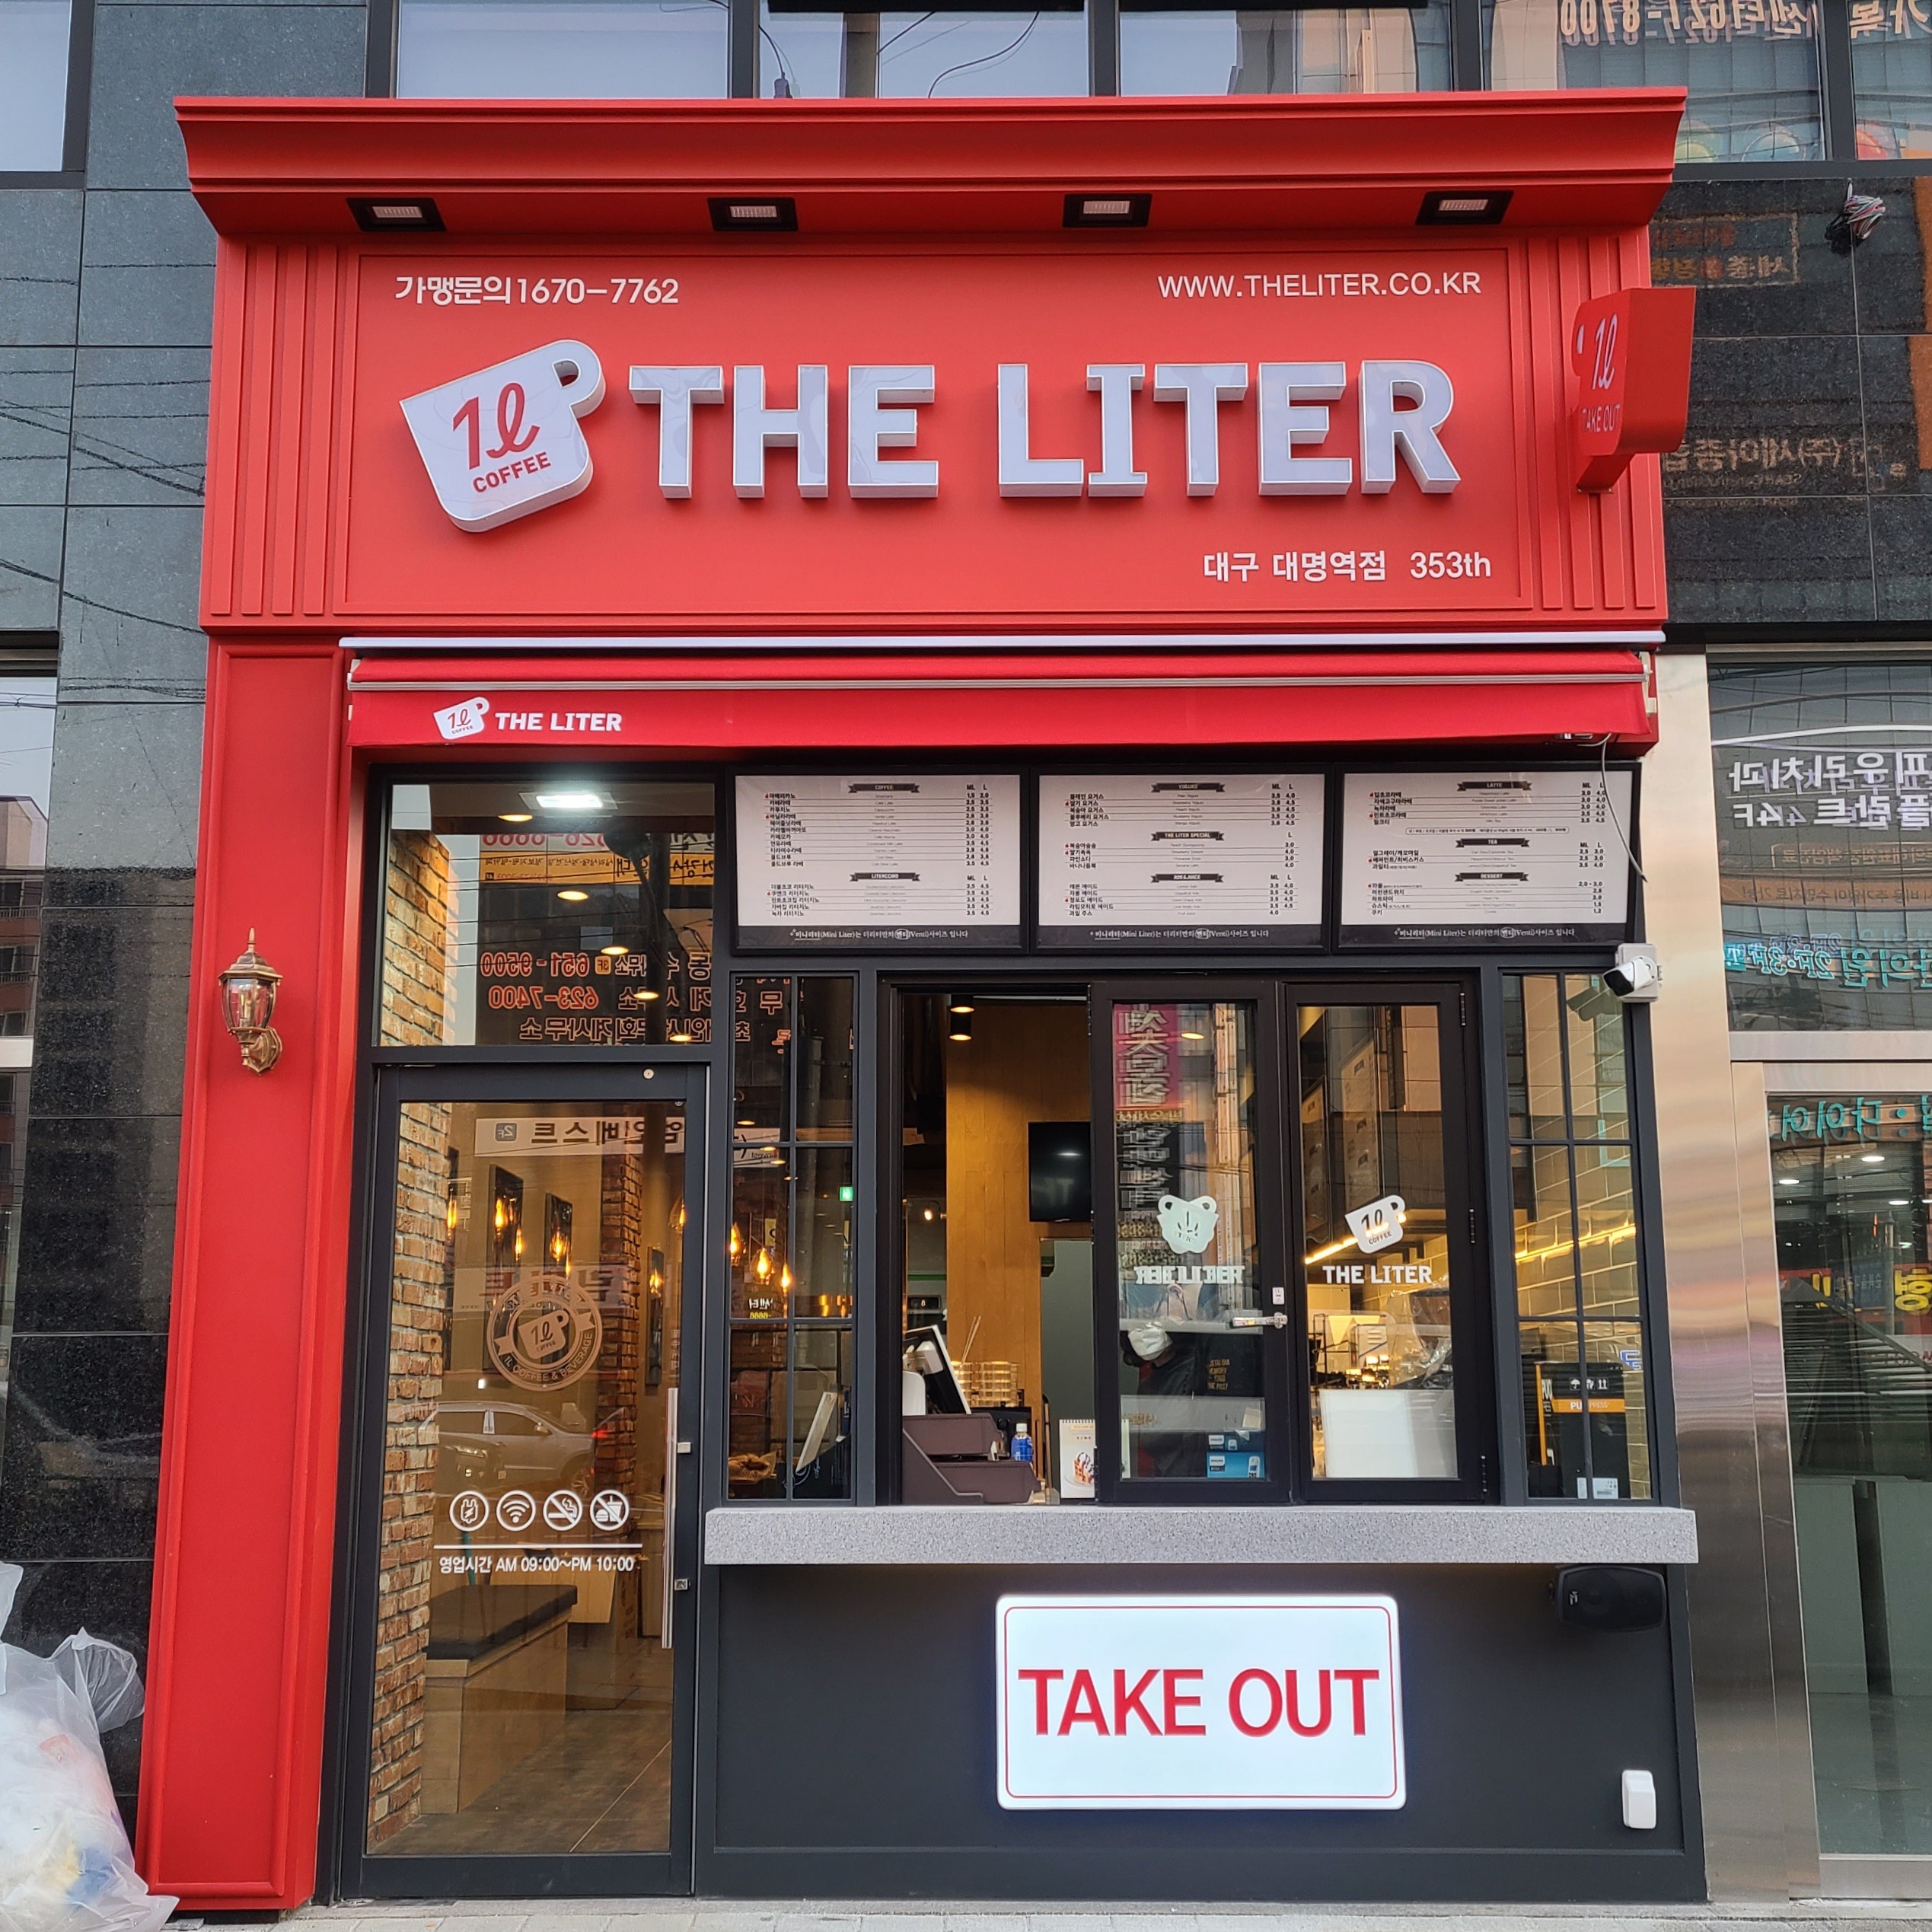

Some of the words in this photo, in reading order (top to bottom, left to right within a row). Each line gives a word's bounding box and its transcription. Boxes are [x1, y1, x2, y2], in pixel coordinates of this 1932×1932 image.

[1157, 271, 1481, 299] WWW.THELITER.CO.KR
[629, 365, 939, 497] THE
[997, 360, 1461, 496] LITER
[1580, 404, 1602, 432] TAKE
[1602, 403, 1621, 432] OUT
[473, 451, 552, 494] COFFEE
[1203, 551, 1261, 583] 대구
[1273, 550, 1387, 582] 대명역점
[1410, 551, 1491, 579] 353th
[451, 725, 473, 735] COFFEE
[495, 713, 543, 731] THE
[550, 713, 622, 732] LITER
[1368, 1230, 1392, 1245] COFFEE
[1322, 1265, 1364, 1284] THE
[1370, 1265, 1433, 1284] LITER
[512, 1364, 550, 1382] COFFEE
[560, 1332, 593, 1379] BEVERAGE
[439, 1556, 492, 1574] 영업시간
[495, 1557, 518, 1573] AM
[596, 1557, 634, 1573] 10:00
[1018, 1668, 1207, 1736] TAKE
[1228, 1667, 1379, 1737] OUT
